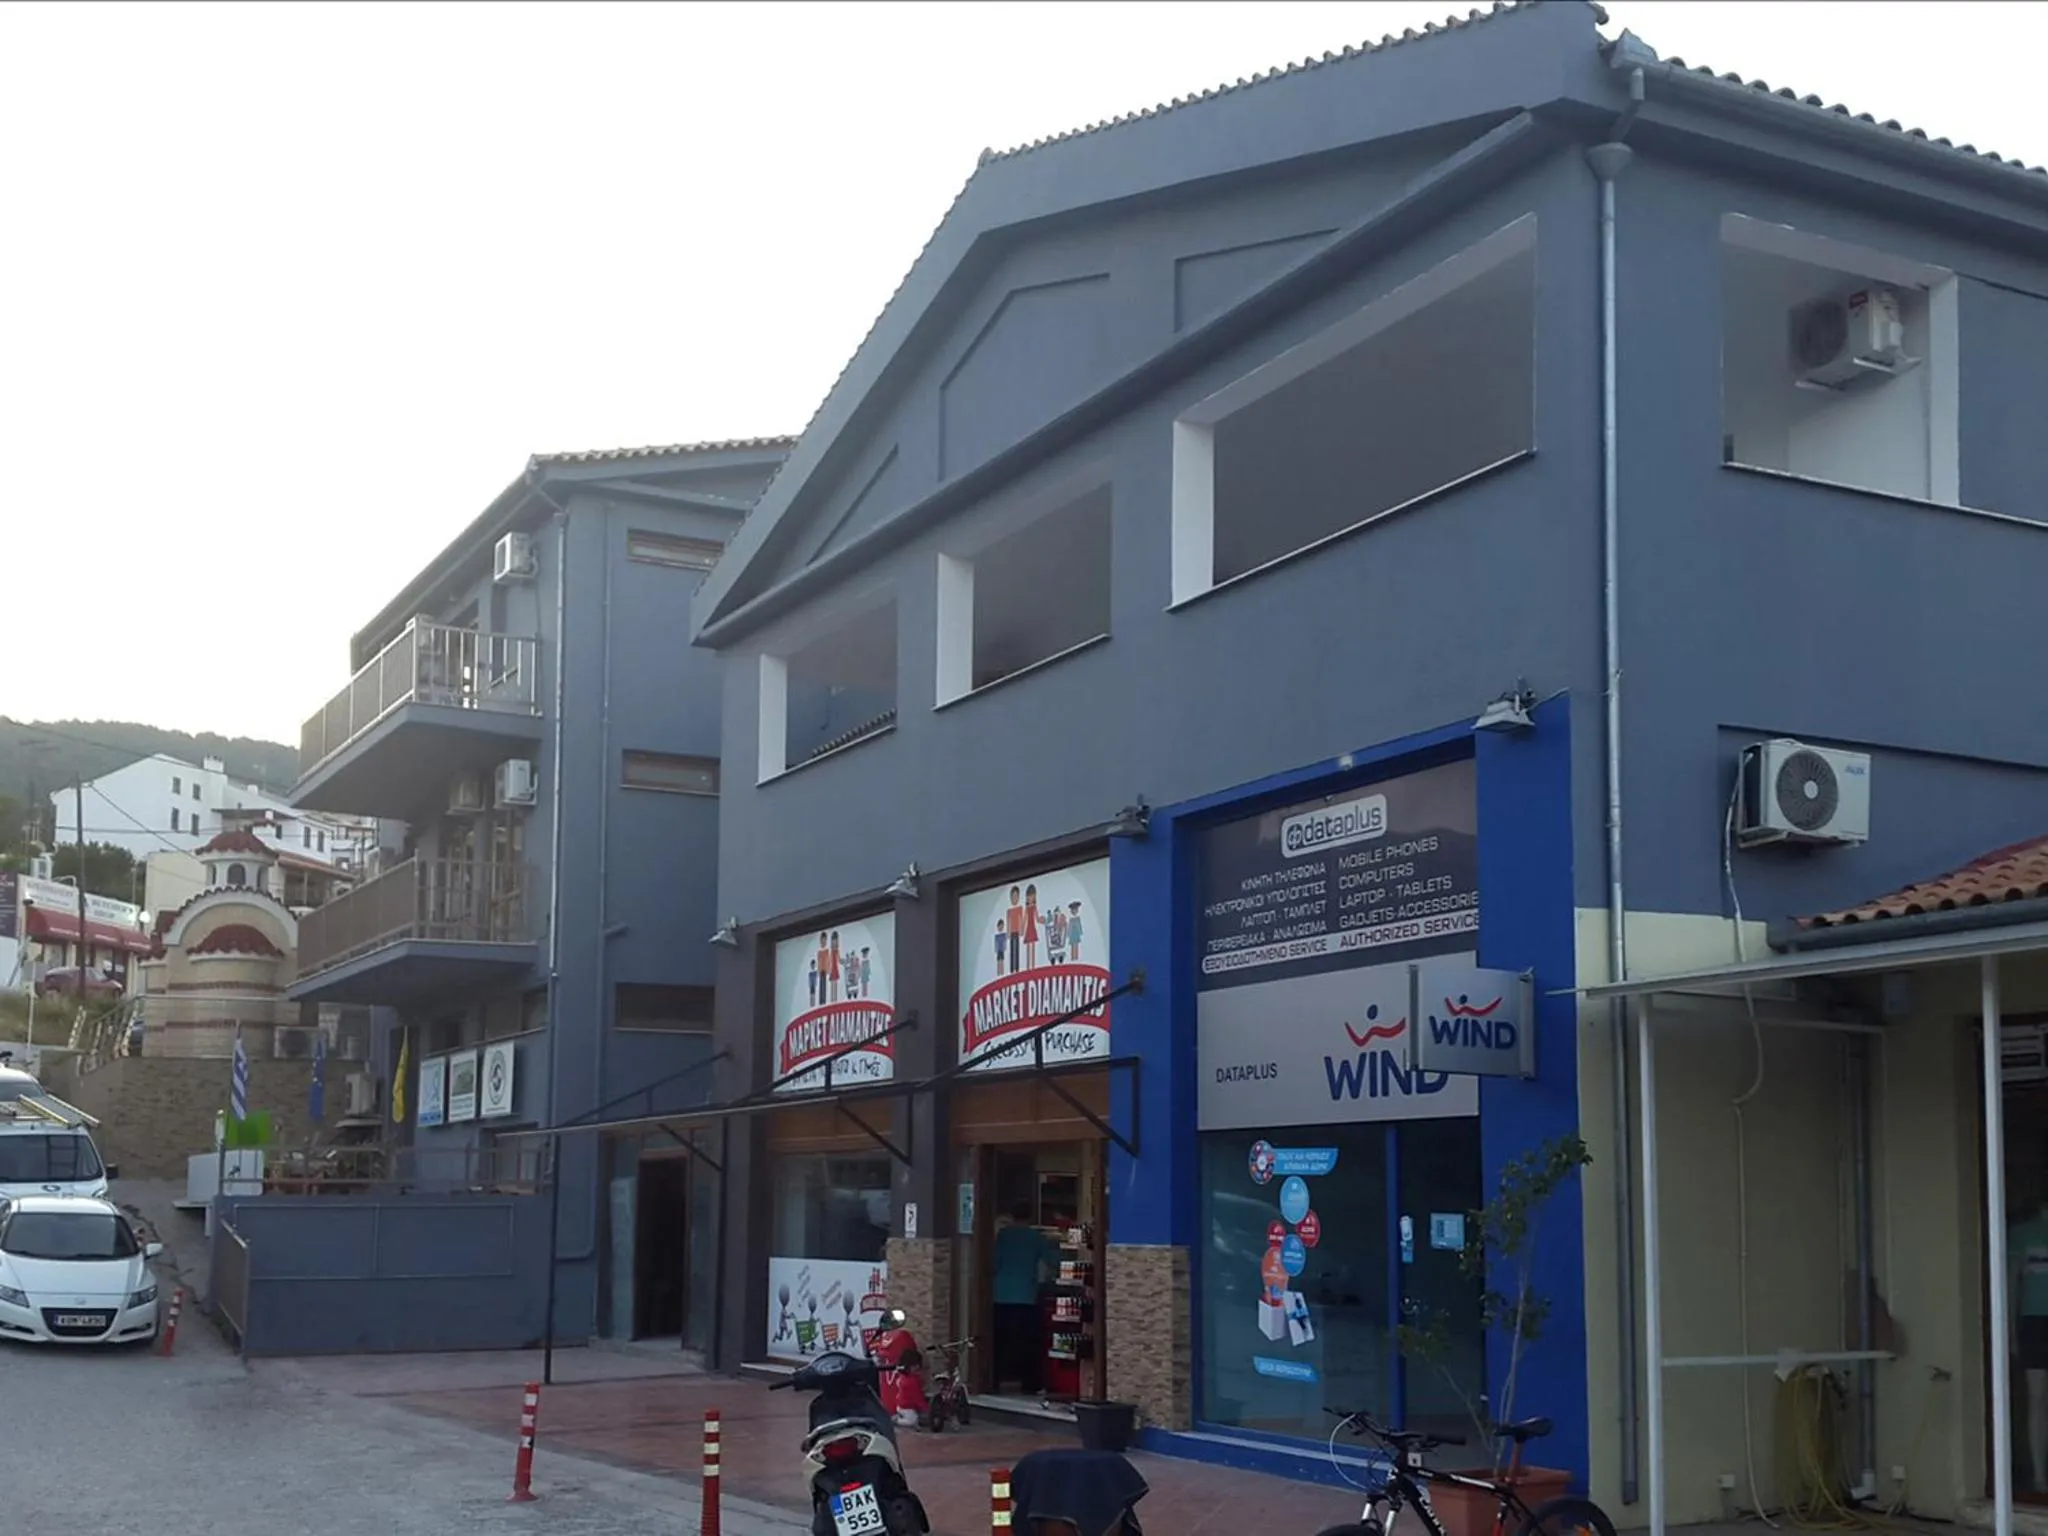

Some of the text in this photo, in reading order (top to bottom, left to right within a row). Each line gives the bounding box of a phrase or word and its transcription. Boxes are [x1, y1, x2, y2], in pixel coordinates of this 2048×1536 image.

[1304, 804, 1383, 843] dataplus
[1338, 836, 1440, 869] MOBILE PHONES
[1338, 862, 1415, 889] COMPUTERS
[1339, 888, 1386, 909] LAPTOP
[1396, 875, 1453, 898] TABLETS
[1397, 891, 1479, 918] ACCESSORIE
[1289, 939, 1328, 956] SERVICE
[1340, 923, 1420, 949] AUTHORIZED
[974, 975, 1107, 1037] MARKET DIAMANTIS
[1045, 1031, 1097, 1055] PURCHASE
[1429, 1015, 1517, 1050] WIND
[1216, 1063, 1278, 1083] DATAPLUS
[1324, 1050, 1449, 1100] WIND
[843, 1488, 874, 1511] BAK
[847, 1508, 880, 1530] 553
